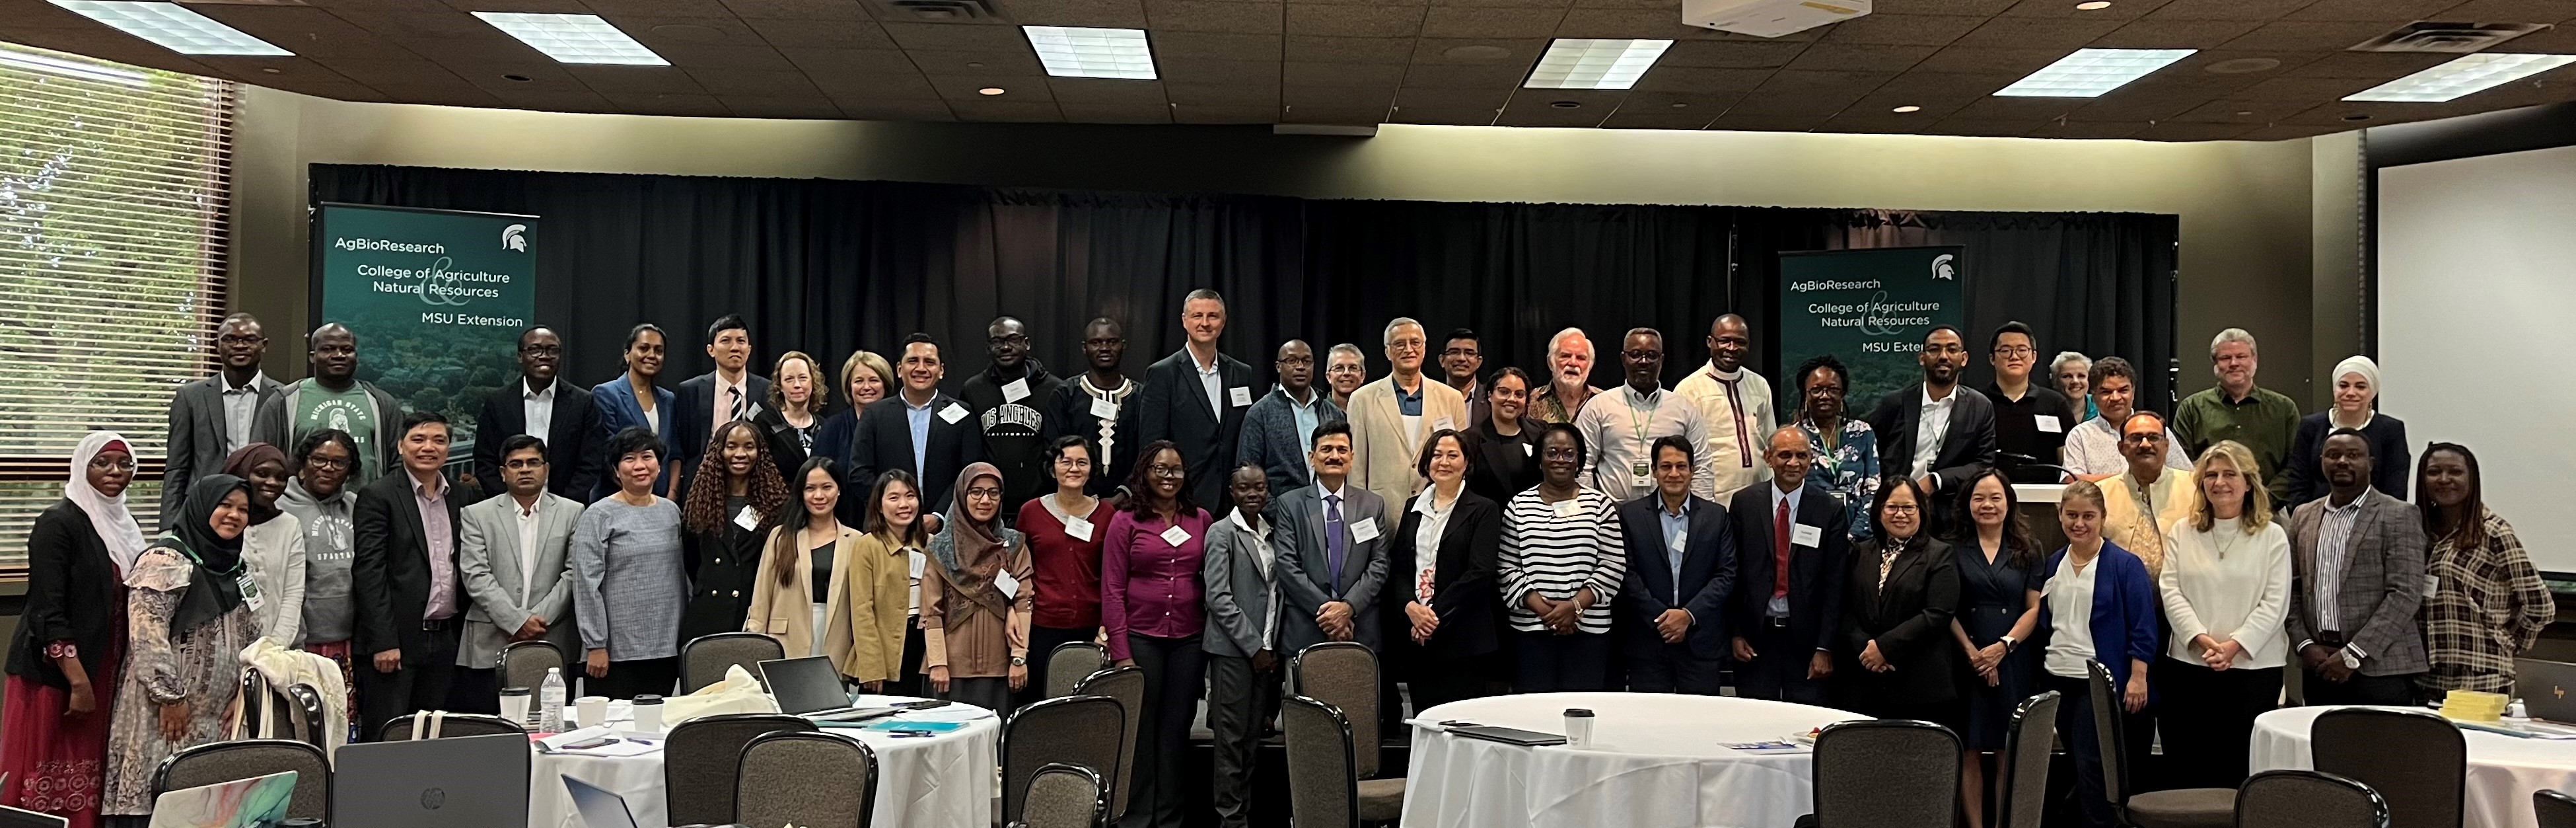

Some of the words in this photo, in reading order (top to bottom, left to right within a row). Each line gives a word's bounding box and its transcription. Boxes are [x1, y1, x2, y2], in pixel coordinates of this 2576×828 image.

[335, 237, 445, 254] AgBioResearch
[357, 264, 411, 279] College
[415, 268, 431, 279] of
[434, 269, 510, 283] Agriculture
[373, 281, 424, 294] Natural
[429, 283, 499, 297] Resources
[1790, 278, 1880, 292] AgBioResearch
[1808, 303, 1853, 315] College
[1856, 302, 1869, 313] of
[1872, 301, 1940, 314] Agriculture
[421, 313, 453, 324] MSU
[458, 314, 523, 327] Extension
[1822, 316, 1864, 327] Natural
[1868, 315, 1930, 326] Resources
[1863, 342, 1890, 352] MSU
[310, 400, 343, 420] MICHIGAN
[345, 402, 366, 420] STATE
[981, 407, 997, 435] LOS
[999, 404, 1042, 433] ANGELES
